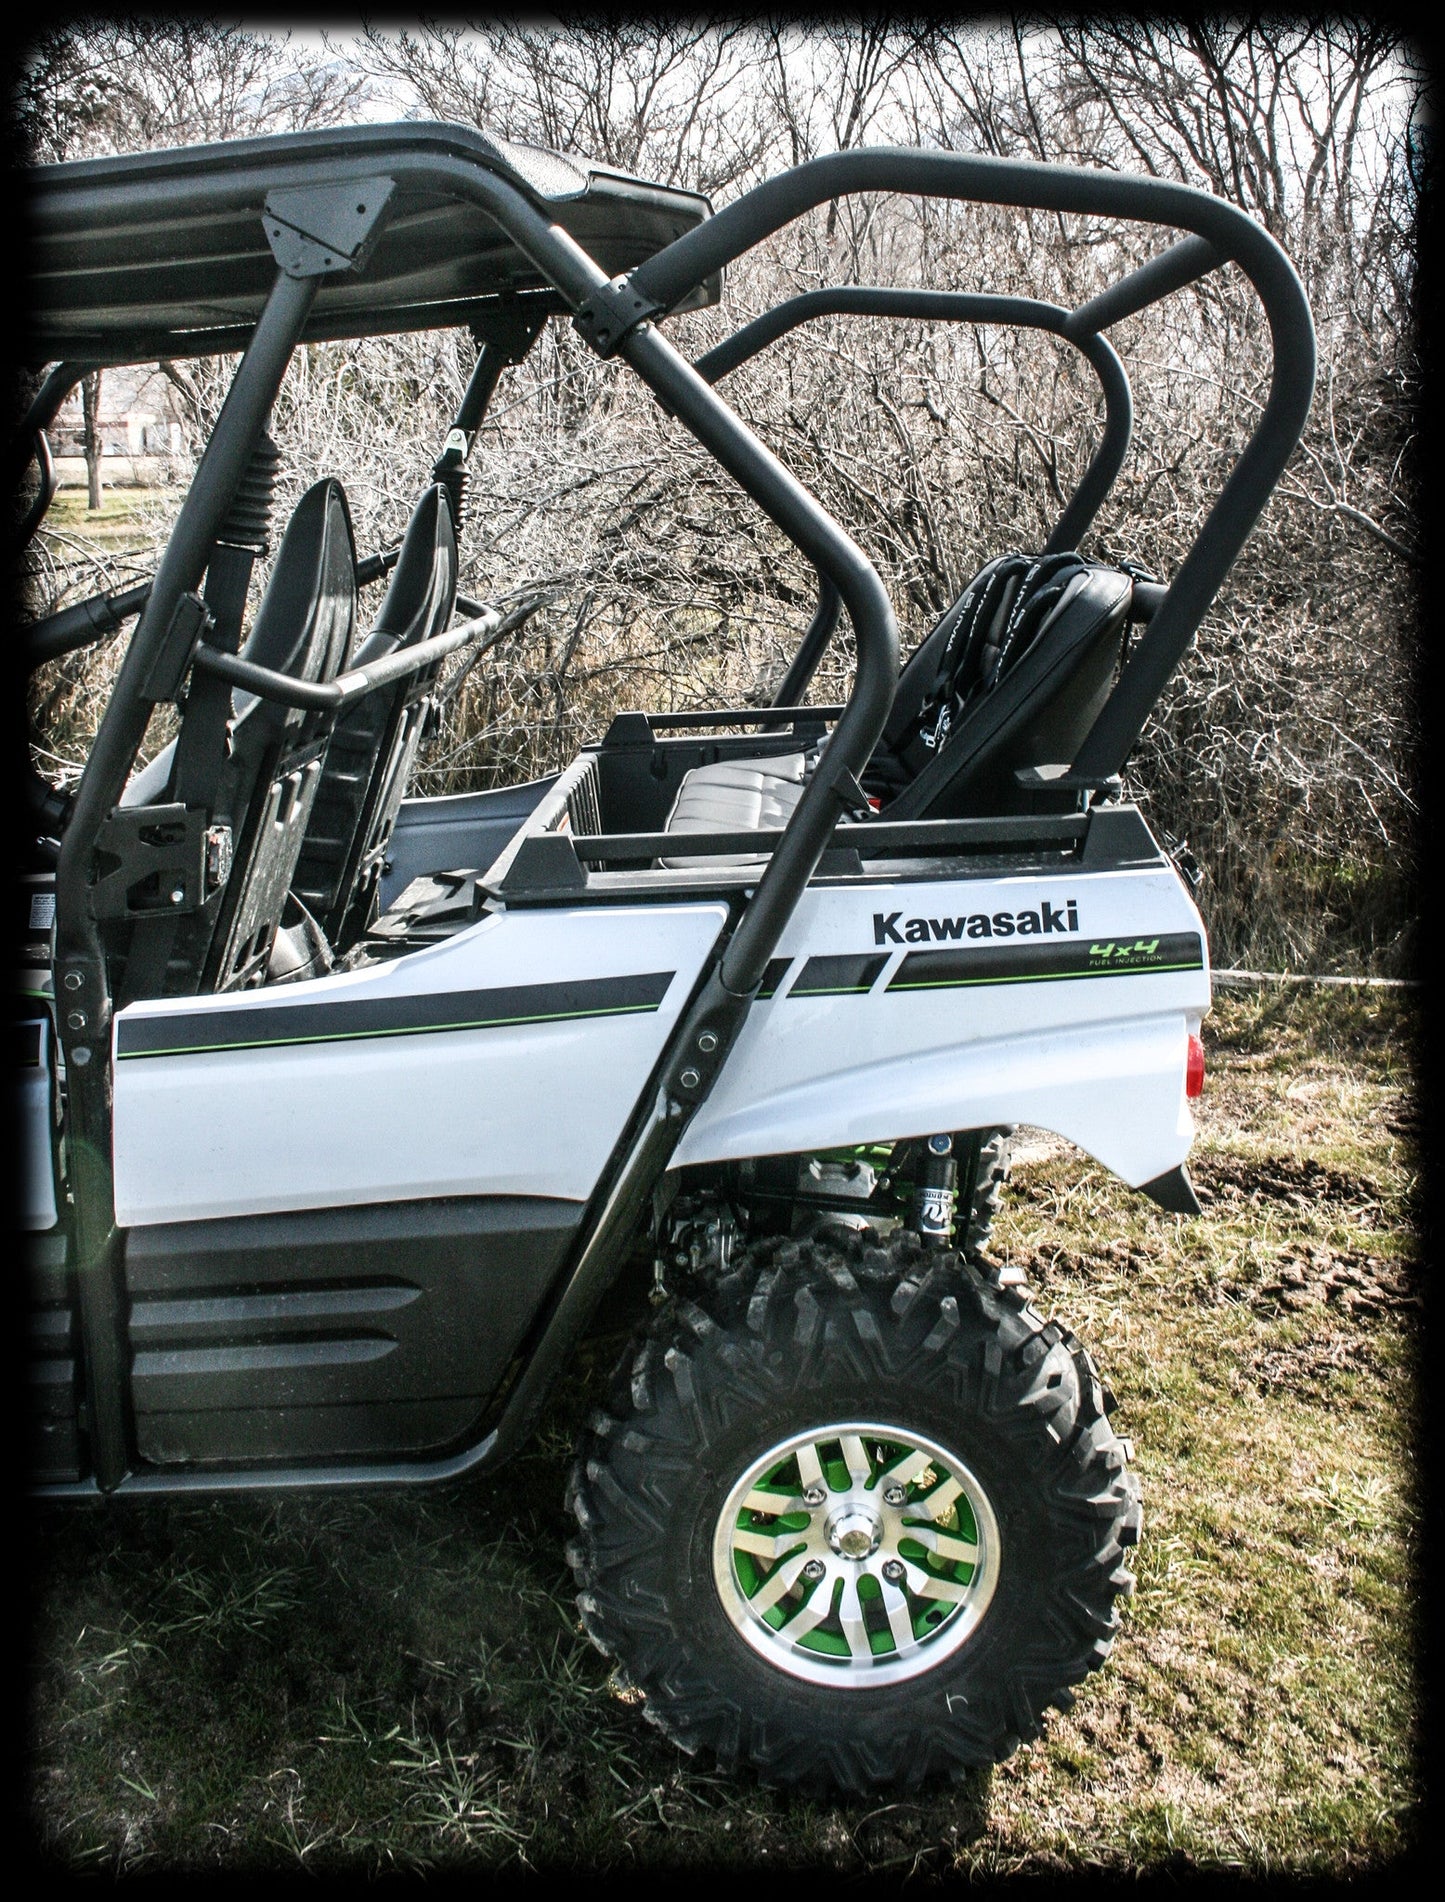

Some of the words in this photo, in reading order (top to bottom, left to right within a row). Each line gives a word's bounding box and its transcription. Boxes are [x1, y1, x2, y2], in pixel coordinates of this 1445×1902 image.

[873, 900, 1079, 945] Kawasaki
[1089, 940, 1159, 957] 4x4
[1089, 959, 1111, 967] FUEL
[1114, 954, 1162, 965] INJECTION
